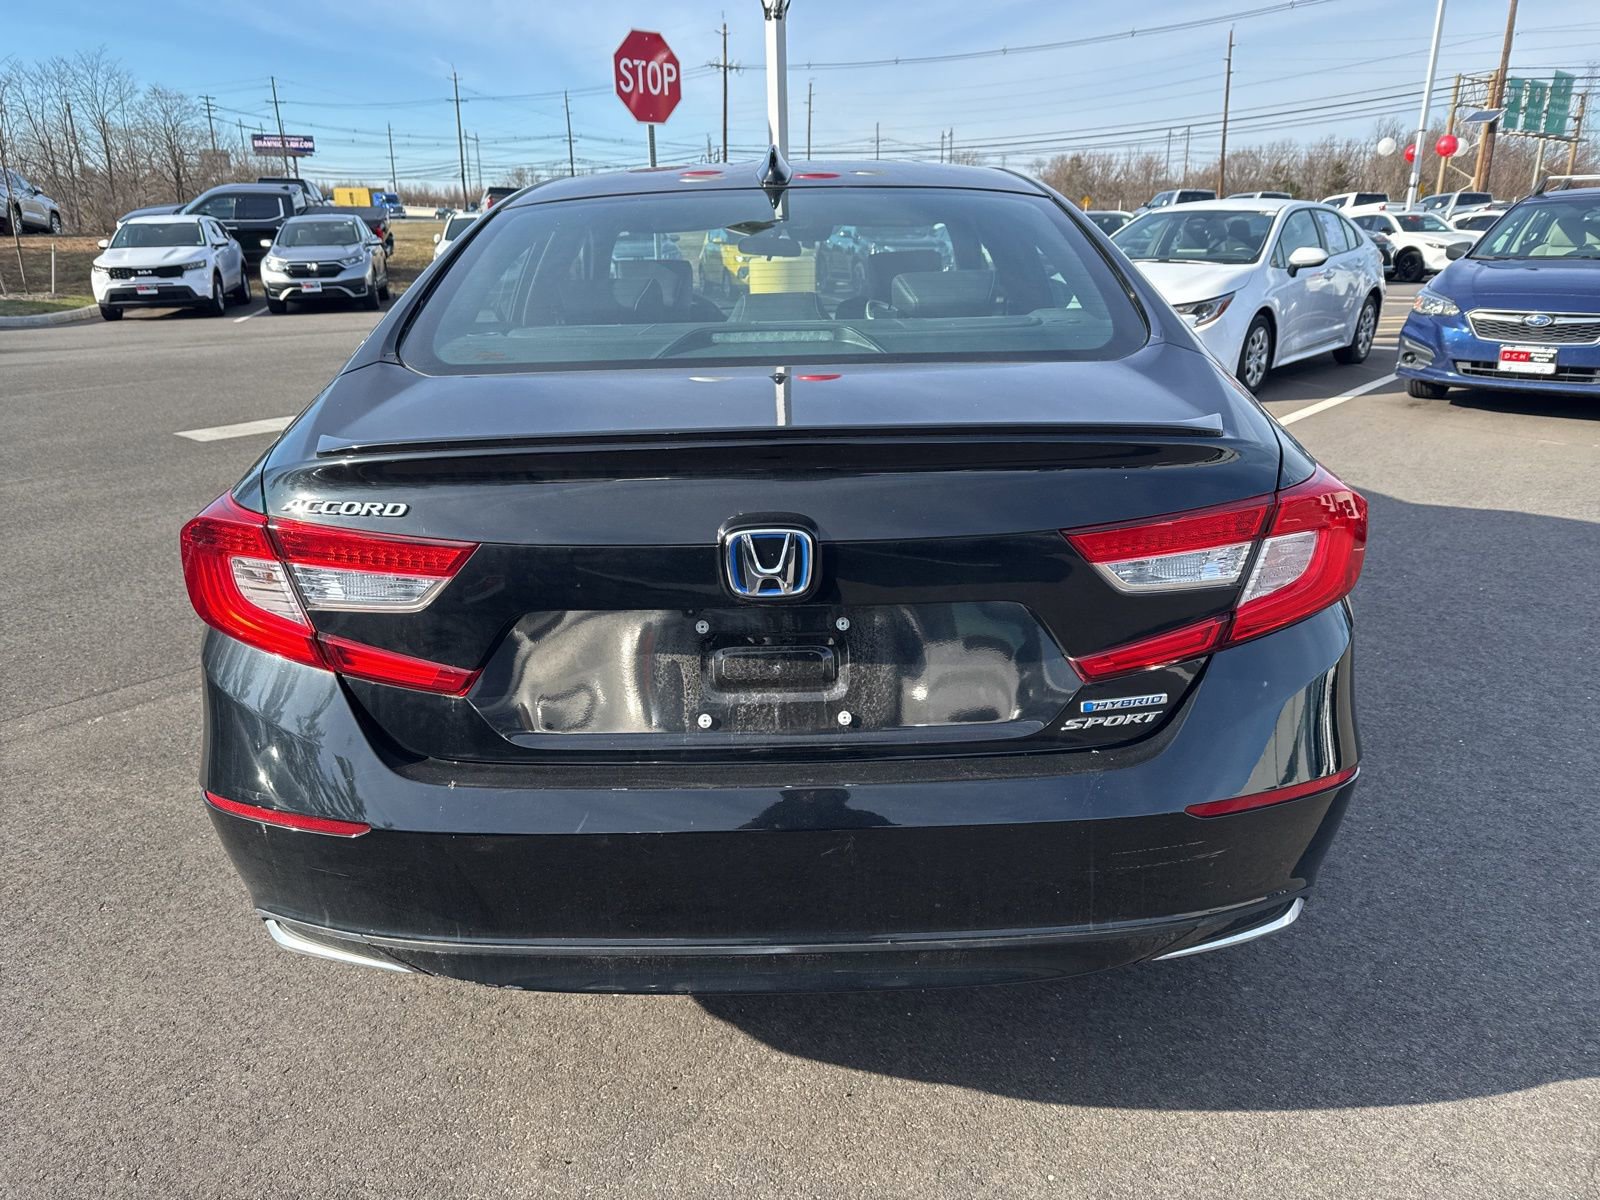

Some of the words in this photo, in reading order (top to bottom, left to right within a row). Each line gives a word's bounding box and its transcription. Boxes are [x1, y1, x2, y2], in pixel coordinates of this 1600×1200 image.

[619, 57, 677, 96] STOP
[1504, 352, 1527, 360] DCH
[281, 499, 409, 517] ACCORD
[1095, 695, 1163, 710] HYBRID
[1060, 711, 1164, 731] SPORT
